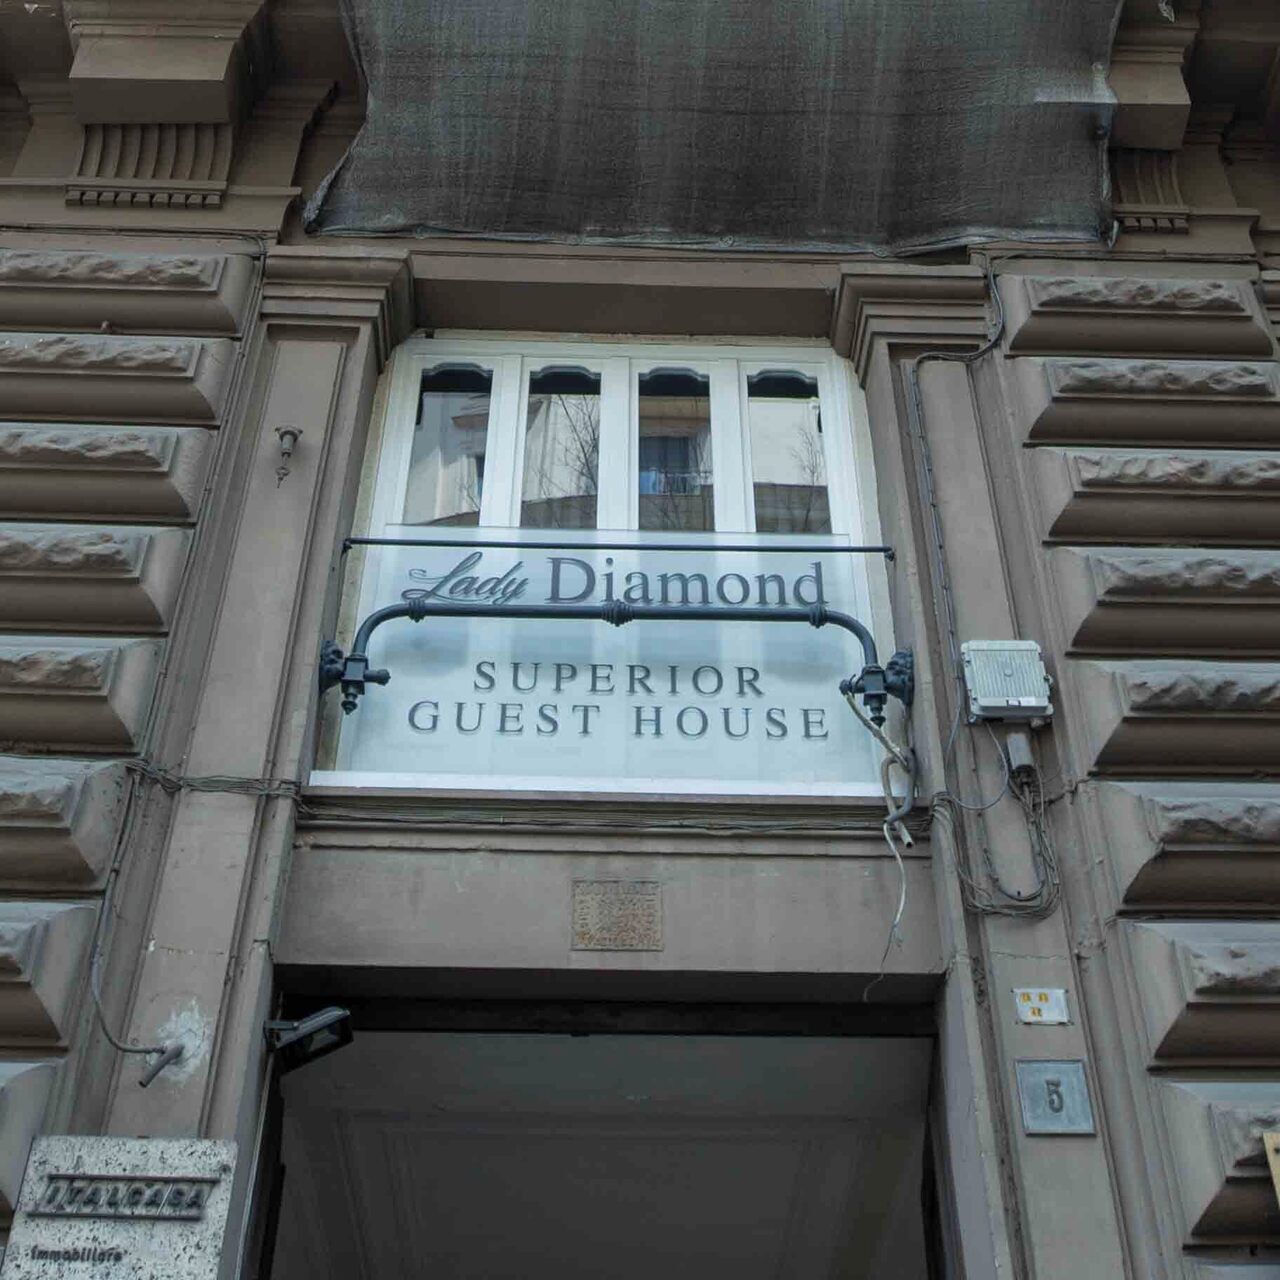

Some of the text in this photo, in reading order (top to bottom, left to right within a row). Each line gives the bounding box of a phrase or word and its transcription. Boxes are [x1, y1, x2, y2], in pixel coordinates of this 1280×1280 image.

[401, 551, 830, 607] Lady Diamond
[473, 660, 765, 698] SUPERIOR
[407, 700, 830, 740] GUEST HOUSE
[1045, 1079, 1064, 1113] 5
